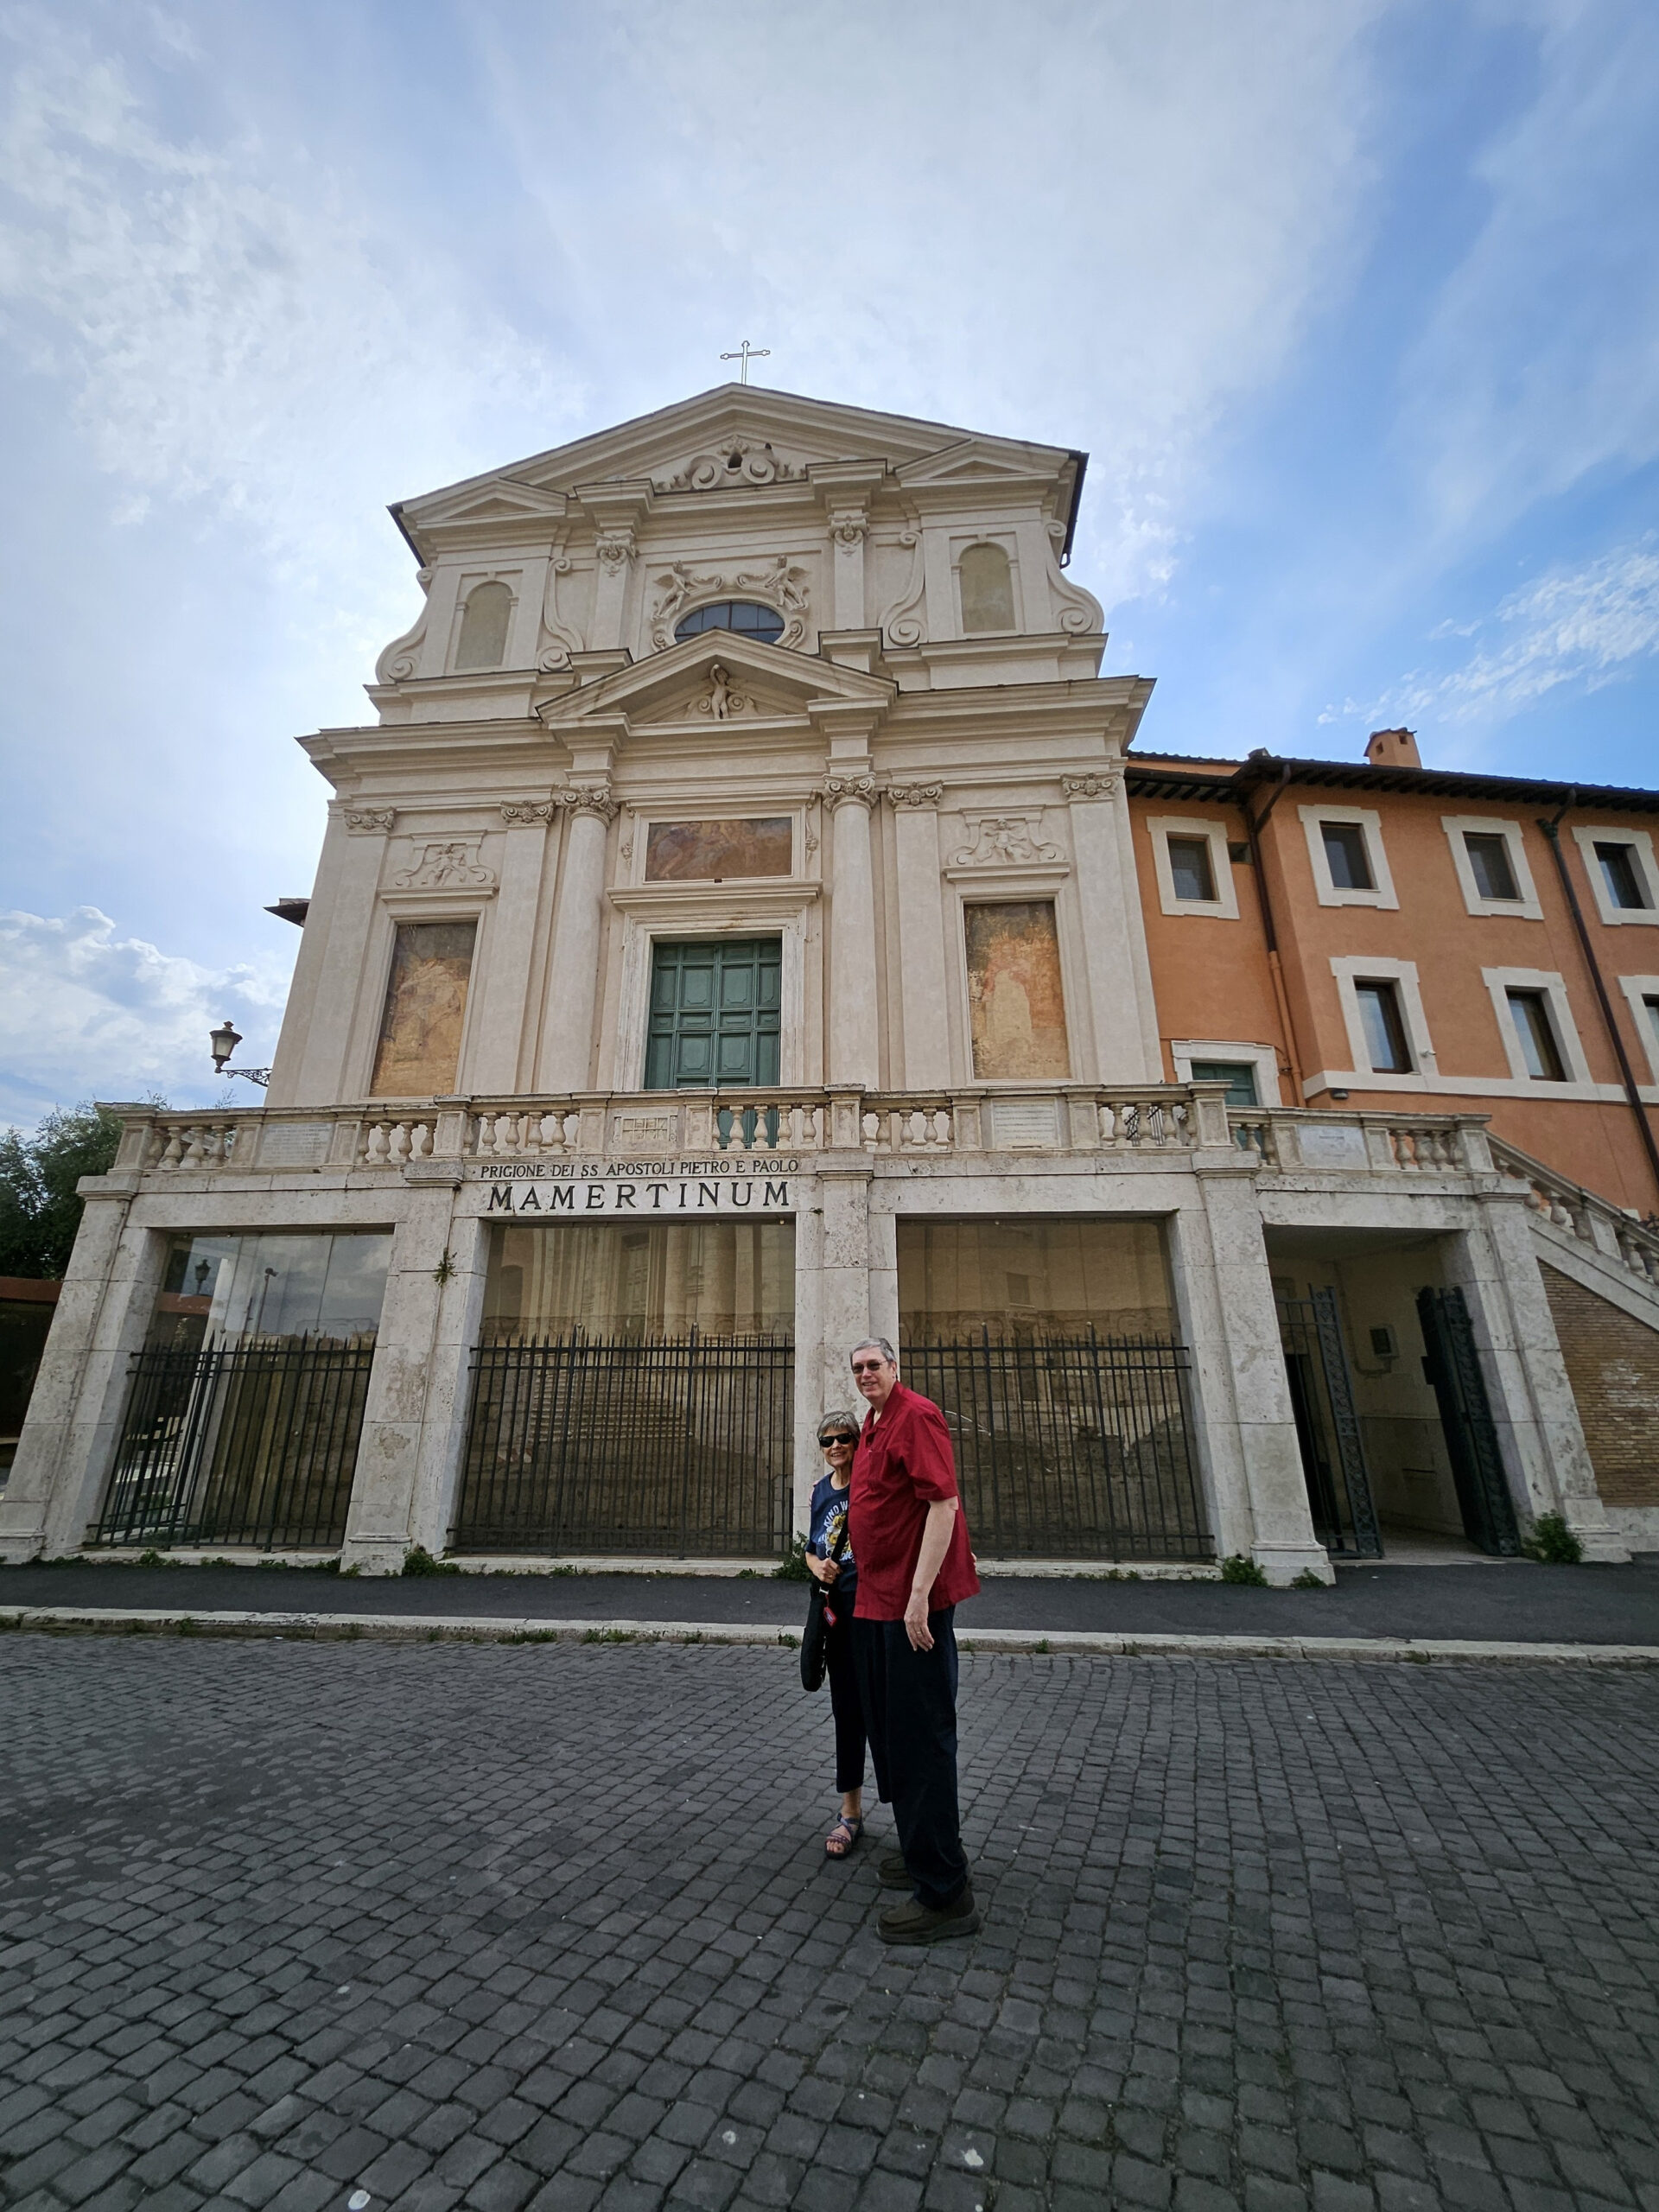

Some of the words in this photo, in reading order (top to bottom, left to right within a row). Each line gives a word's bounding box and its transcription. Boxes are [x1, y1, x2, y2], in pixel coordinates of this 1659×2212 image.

[480, 1164, 545, 1179] PRIGIONE
[551, 1163, 575, 1177] DEI
[581, 1163, 598, 1177] SS
[606, 1162, 675, 1176] APOSTOLI
[680, 1160, 730, 1174] PIETRO
[735, 1160, 746, 1173] E
[753, 1160, 798, 1173] PAOLO
[486, 1181, 789, 1211] MAMERTINUM
[823, 1504, 839, 1527] KIND
